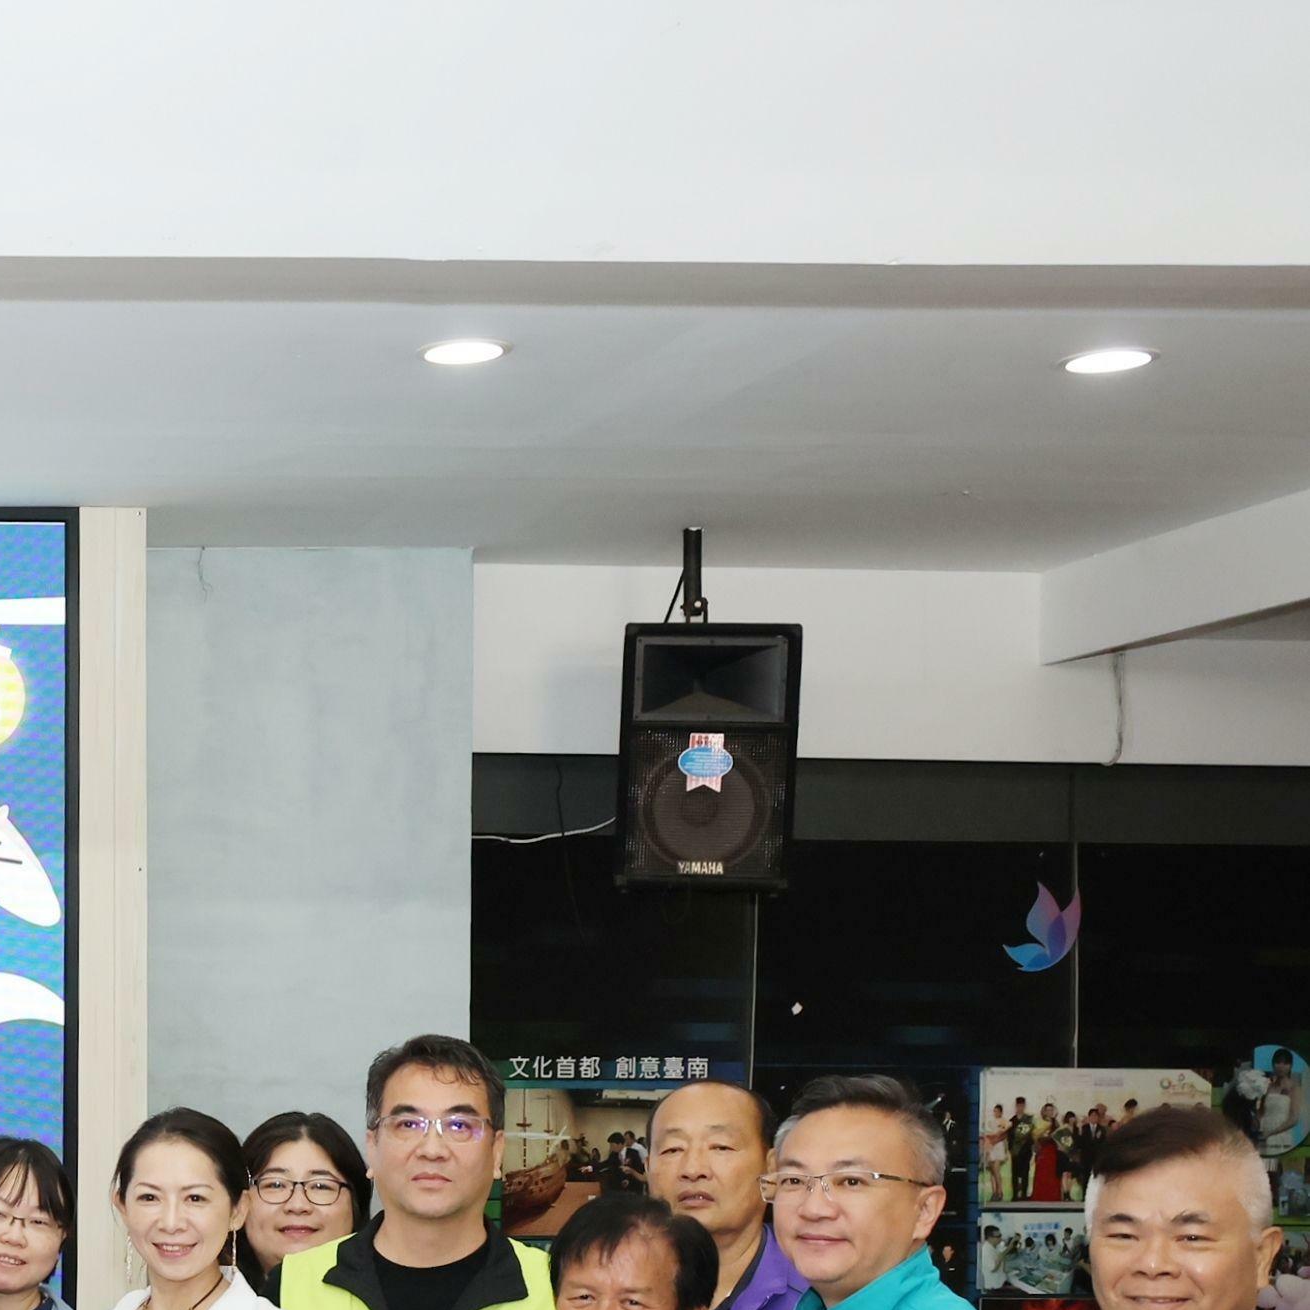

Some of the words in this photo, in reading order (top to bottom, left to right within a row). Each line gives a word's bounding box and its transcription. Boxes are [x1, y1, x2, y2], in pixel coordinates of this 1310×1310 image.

[678, 862, 723, 875] YAMAHA
[509, 1056, 600, 1079] 文化首都
[615, 1056, 709, 1079] 創意臺南
